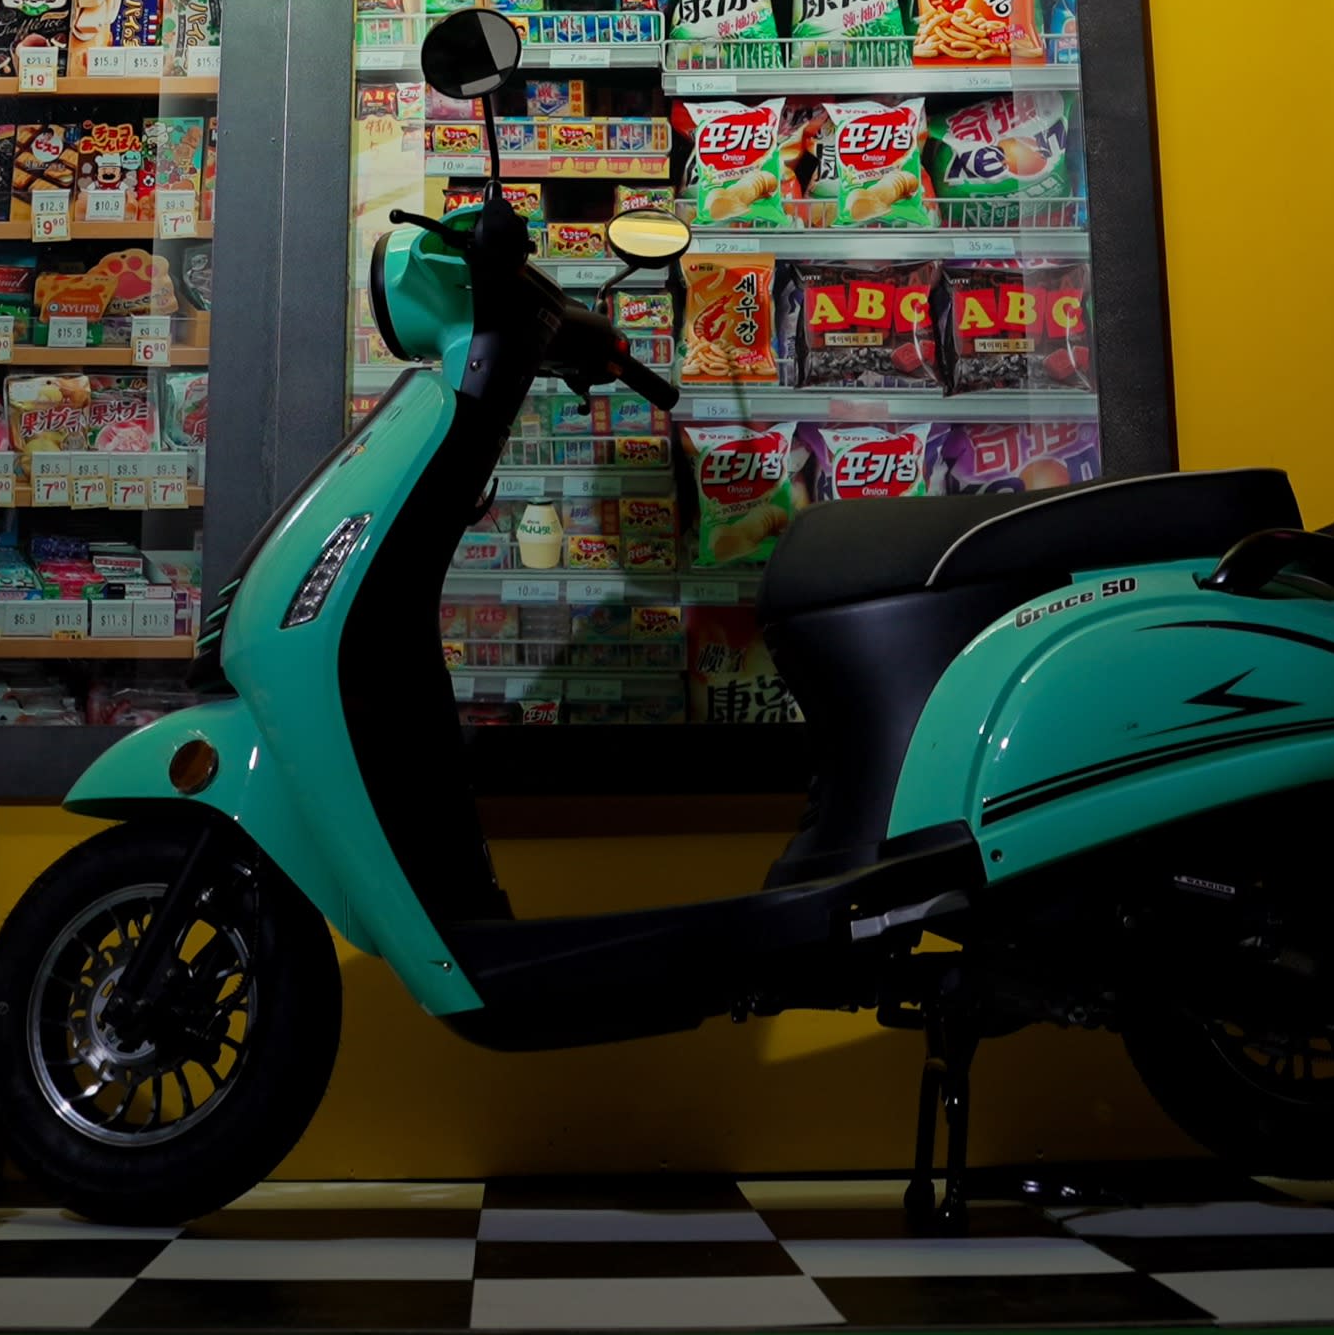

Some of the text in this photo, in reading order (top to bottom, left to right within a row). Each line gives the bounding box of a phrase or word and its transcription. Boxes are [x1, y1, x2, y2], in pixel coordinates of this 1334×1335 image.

[700, 123, 773, 154] 포카칩
[839, 122, 912, 154] 포카칩
[721, 152, 747, 163] Onion
[861, 152, 887, 163] Onion
[732, 271, 760, 344] 새우깡
[21, 408, 82, 438] 果汁グミ
[90, 400, 148, 428] 果汁グミ
[702, 449, 783, 485] 포카칩
[838, 449, 919, 485] 포카칩
[726, 484, 754, 496] Onion
[861, 486, 889, 497] Onion
[1014, 576, 1137, 629] Grace 50
